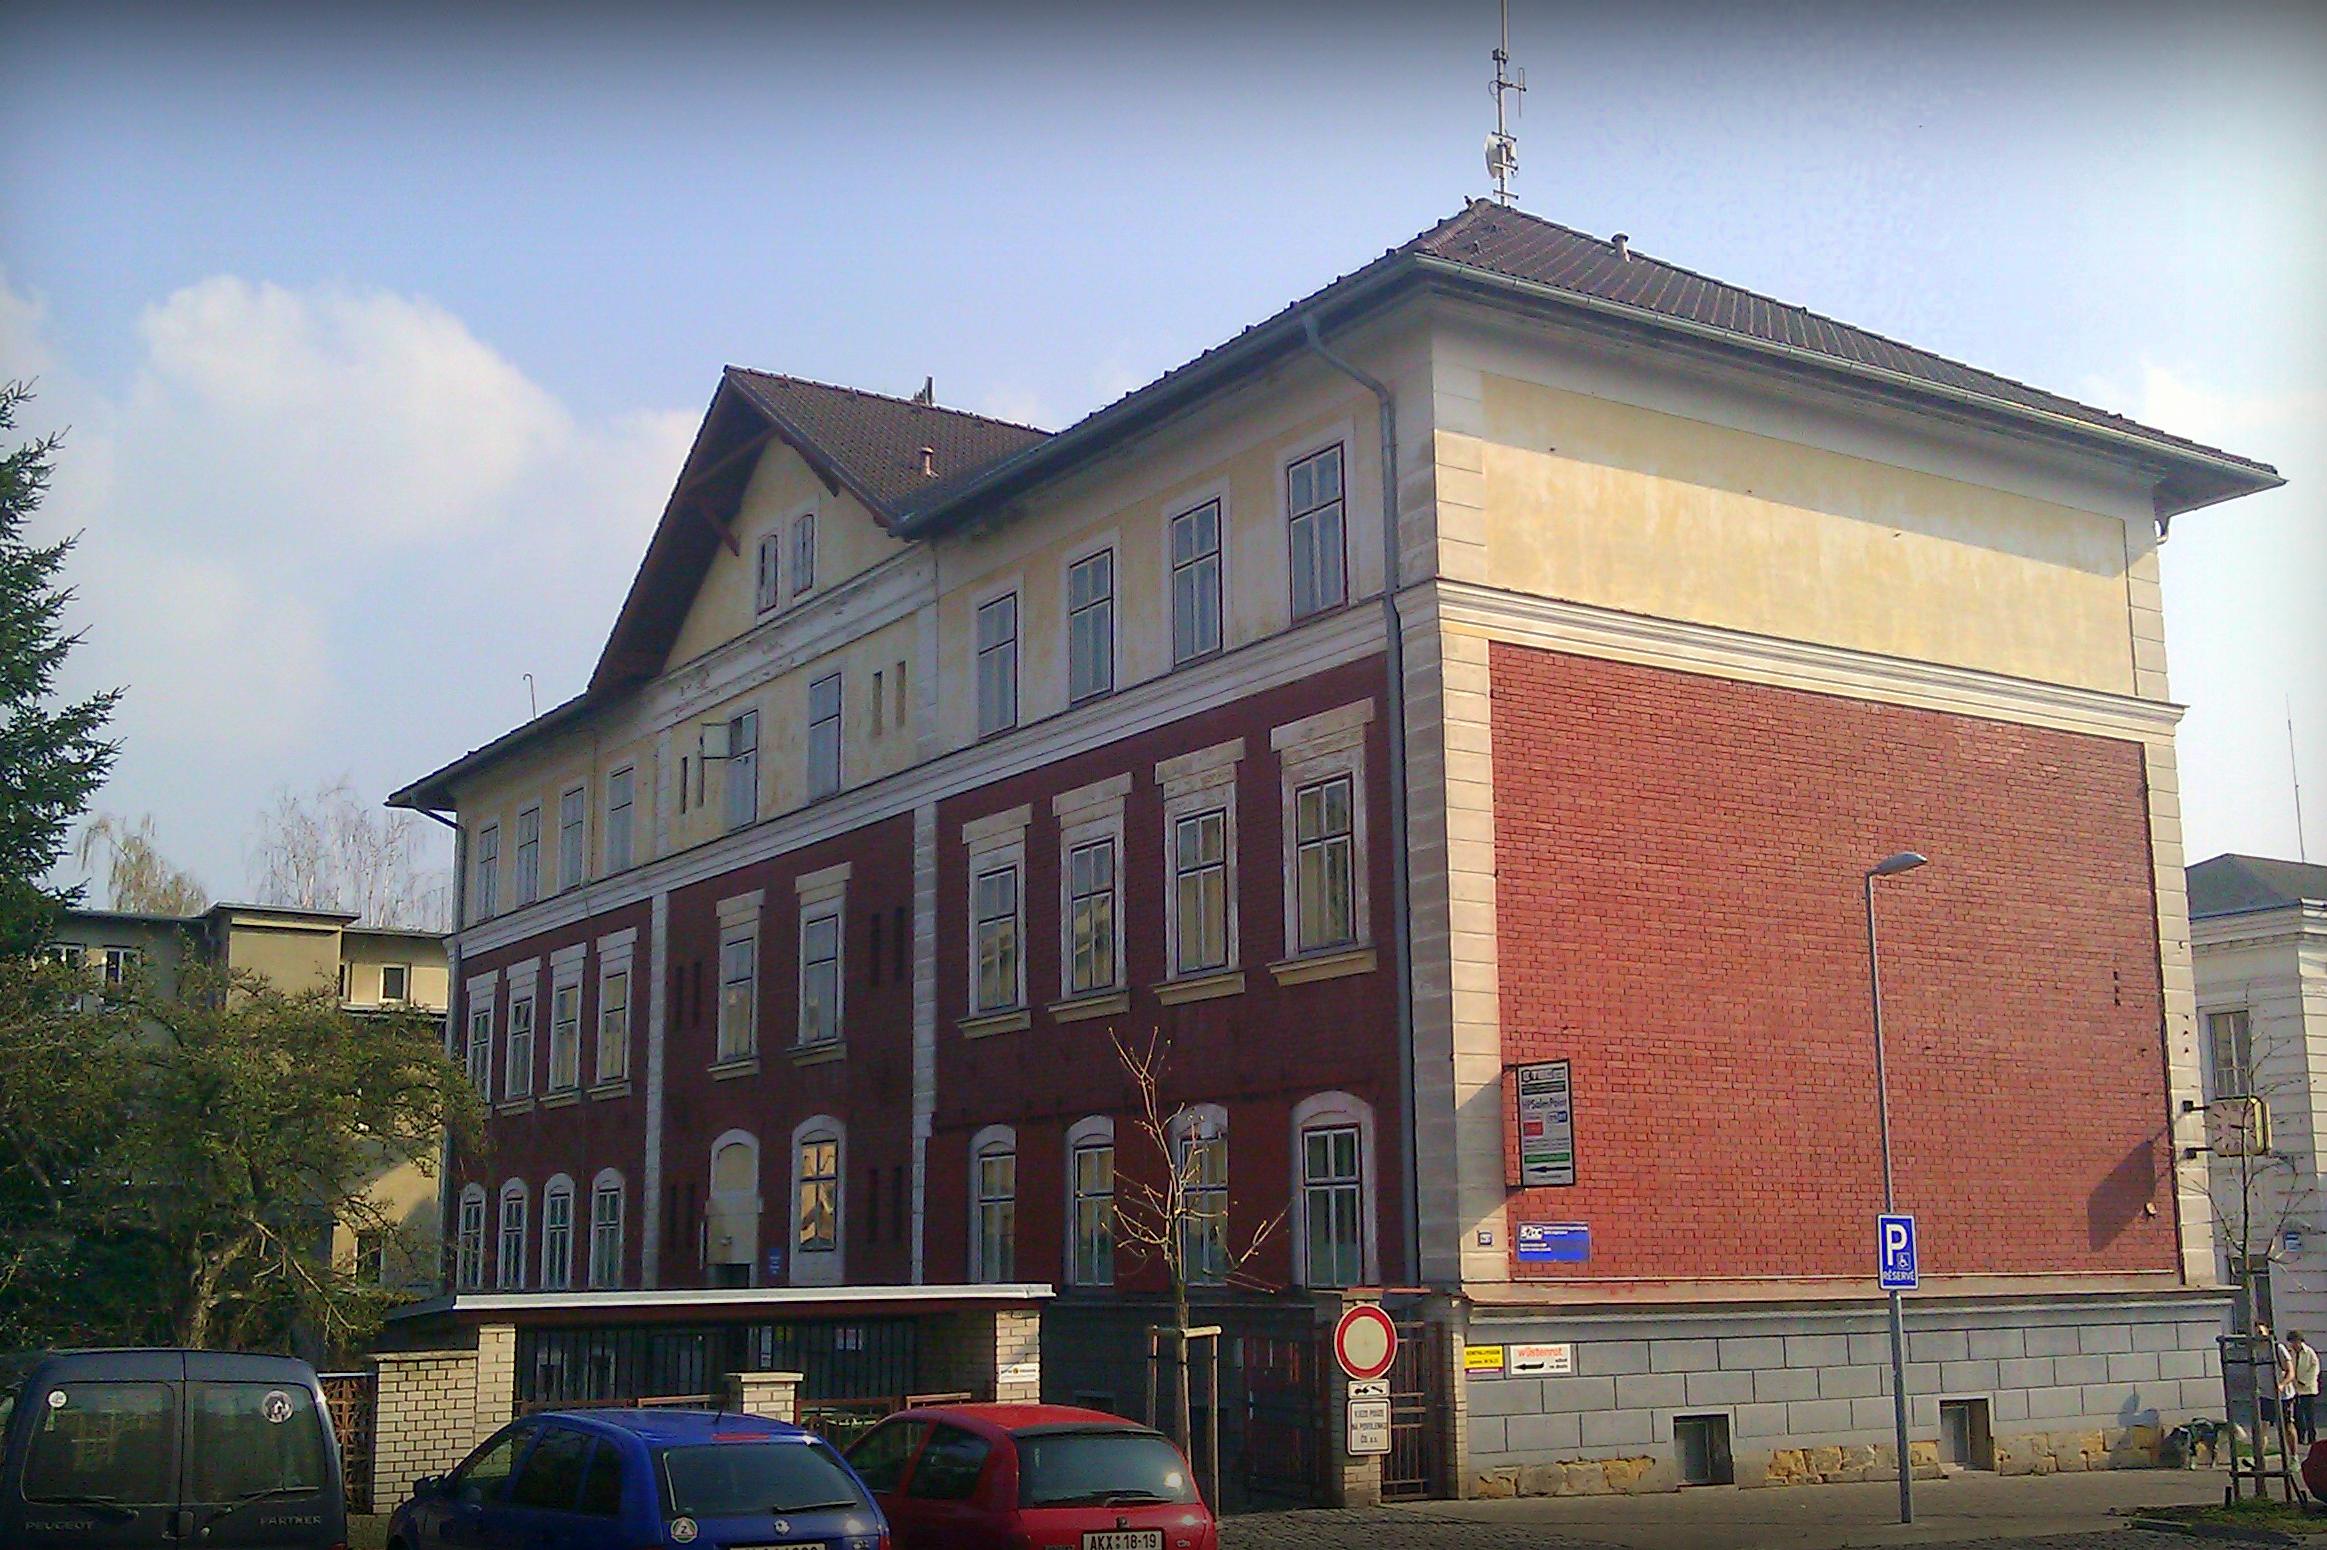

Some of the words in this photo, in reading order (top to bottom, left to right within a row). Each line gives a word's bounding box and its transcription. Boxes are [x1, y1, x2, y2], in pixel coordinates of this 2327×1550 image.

[1886, 1224, 1907, 1265] P
[1517, 1347, 1563, 1357] wüstenrot
[25, 1521, 94, 1531] PEUGEOT
[260, 1516, 321, 1526] PARTNER
